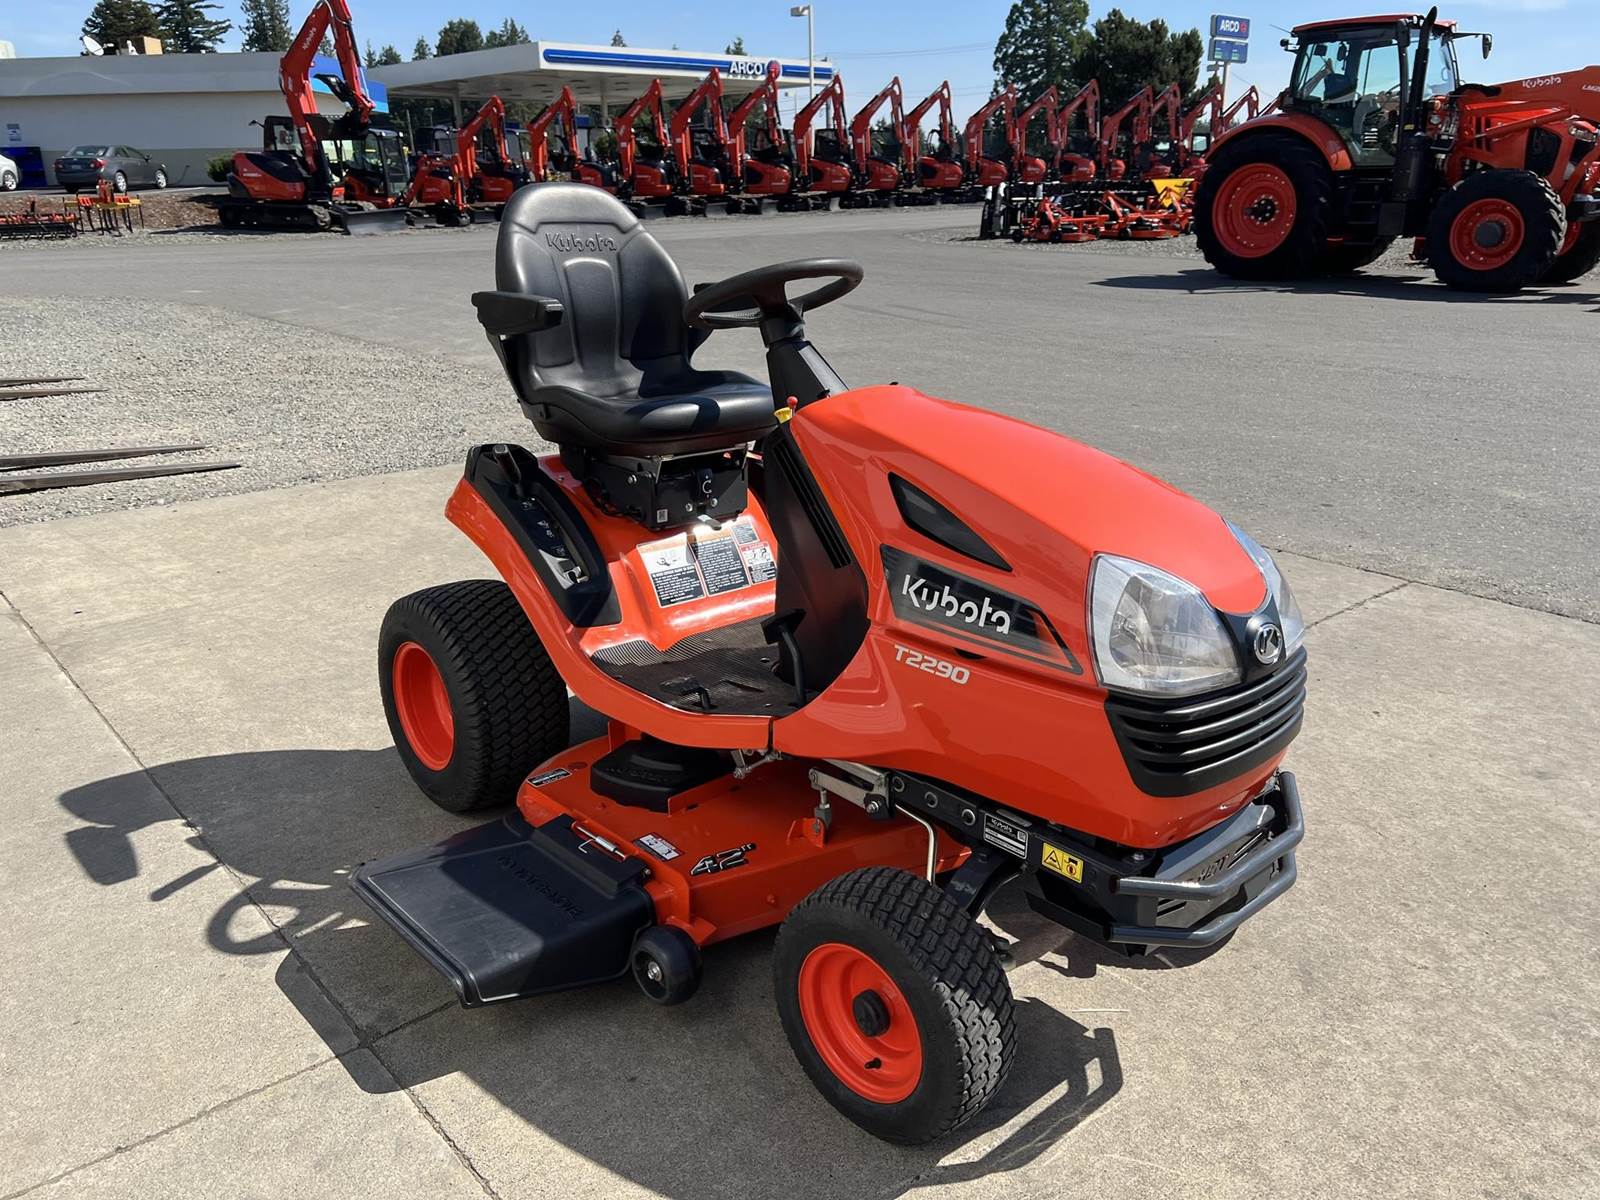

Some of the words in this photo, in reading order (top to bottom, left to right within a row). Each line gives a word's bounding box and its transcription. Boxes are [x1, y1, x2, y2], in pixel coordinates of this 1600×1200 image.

[1220, 19, 1240, 32] ARCO
[729, 61, 763, 75] ARCO
[1522, 76, 1561, 88] Kubota
[545, 232, 617, 252] Kubota
[902, 574, 1011, 635] Kubota
[894, 643, 970, 685] T2290
